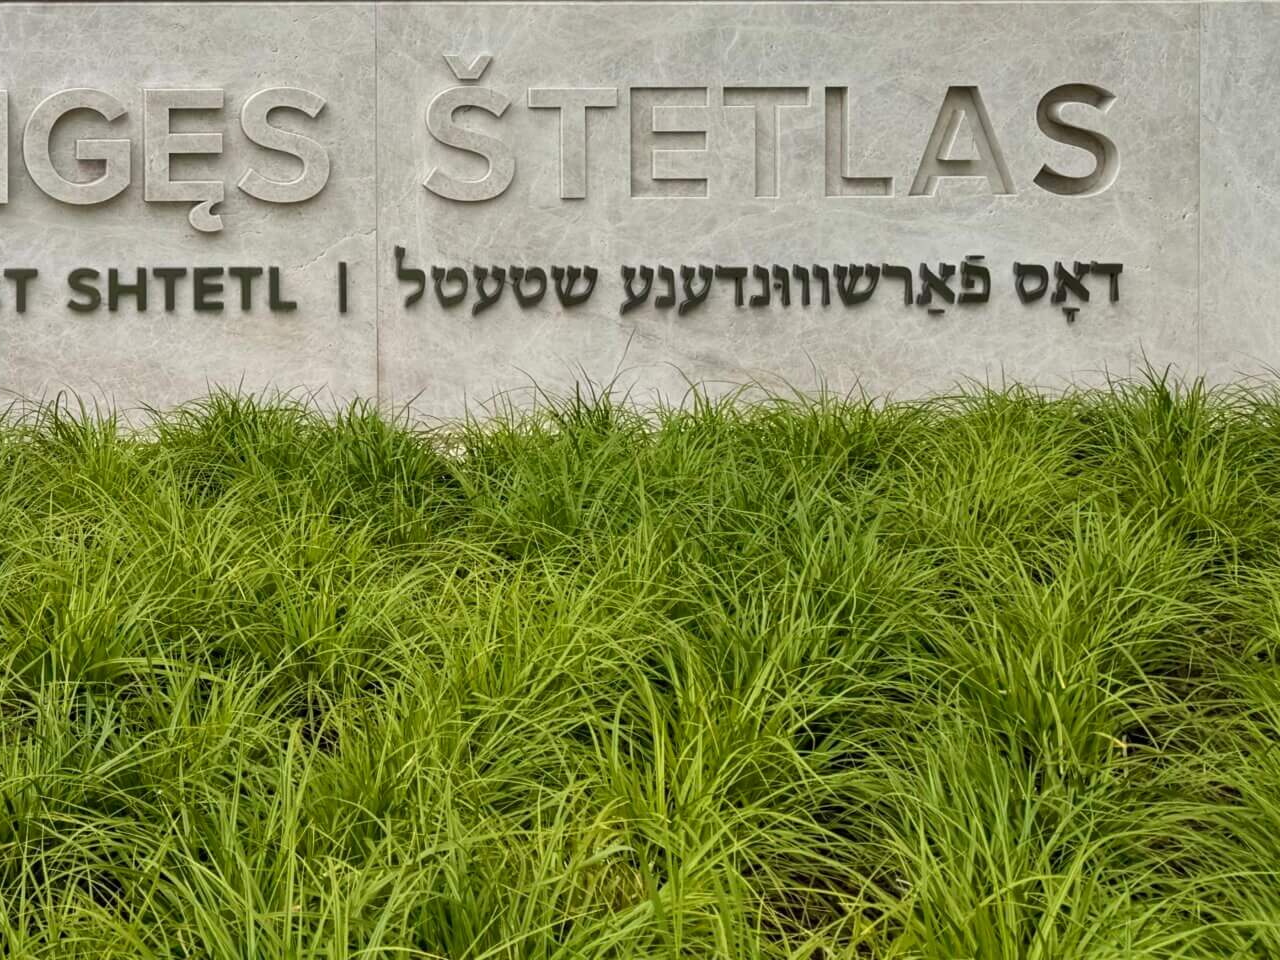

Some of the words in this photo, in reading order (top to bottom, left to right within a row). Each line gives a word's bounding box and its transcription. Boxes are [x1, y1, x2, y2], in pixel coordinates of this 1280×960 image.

[422, 53, 1120, 203] ŠTETLAS
[66, 265, 297, 313] SHTETL
[394, 245, 599, 316] שטעטל
